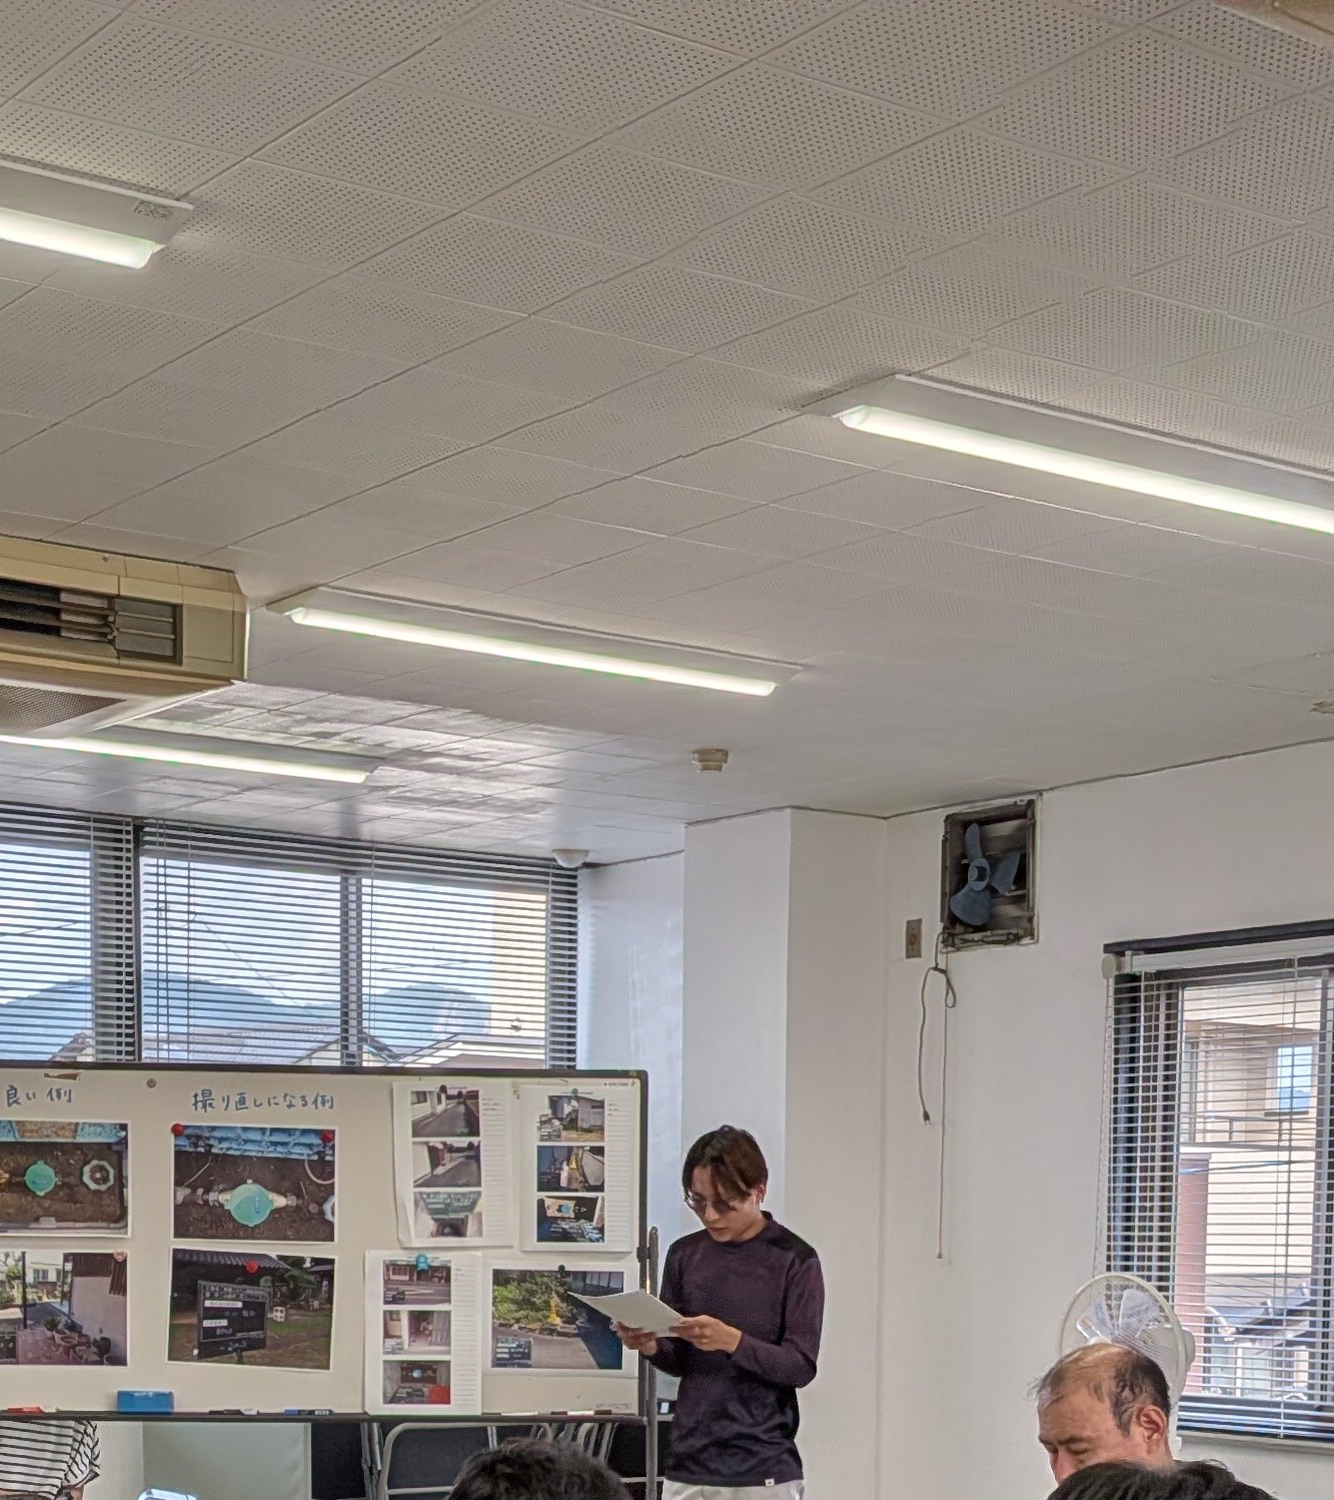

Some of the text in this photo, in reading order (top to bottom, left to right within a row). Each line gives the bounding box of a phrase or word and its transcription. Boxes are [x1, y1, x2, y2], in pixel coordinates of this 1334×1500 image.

[6, 1084, 73, 1108] 良い例
[192, 1088, 335, 1113] 撮り直しになる例
